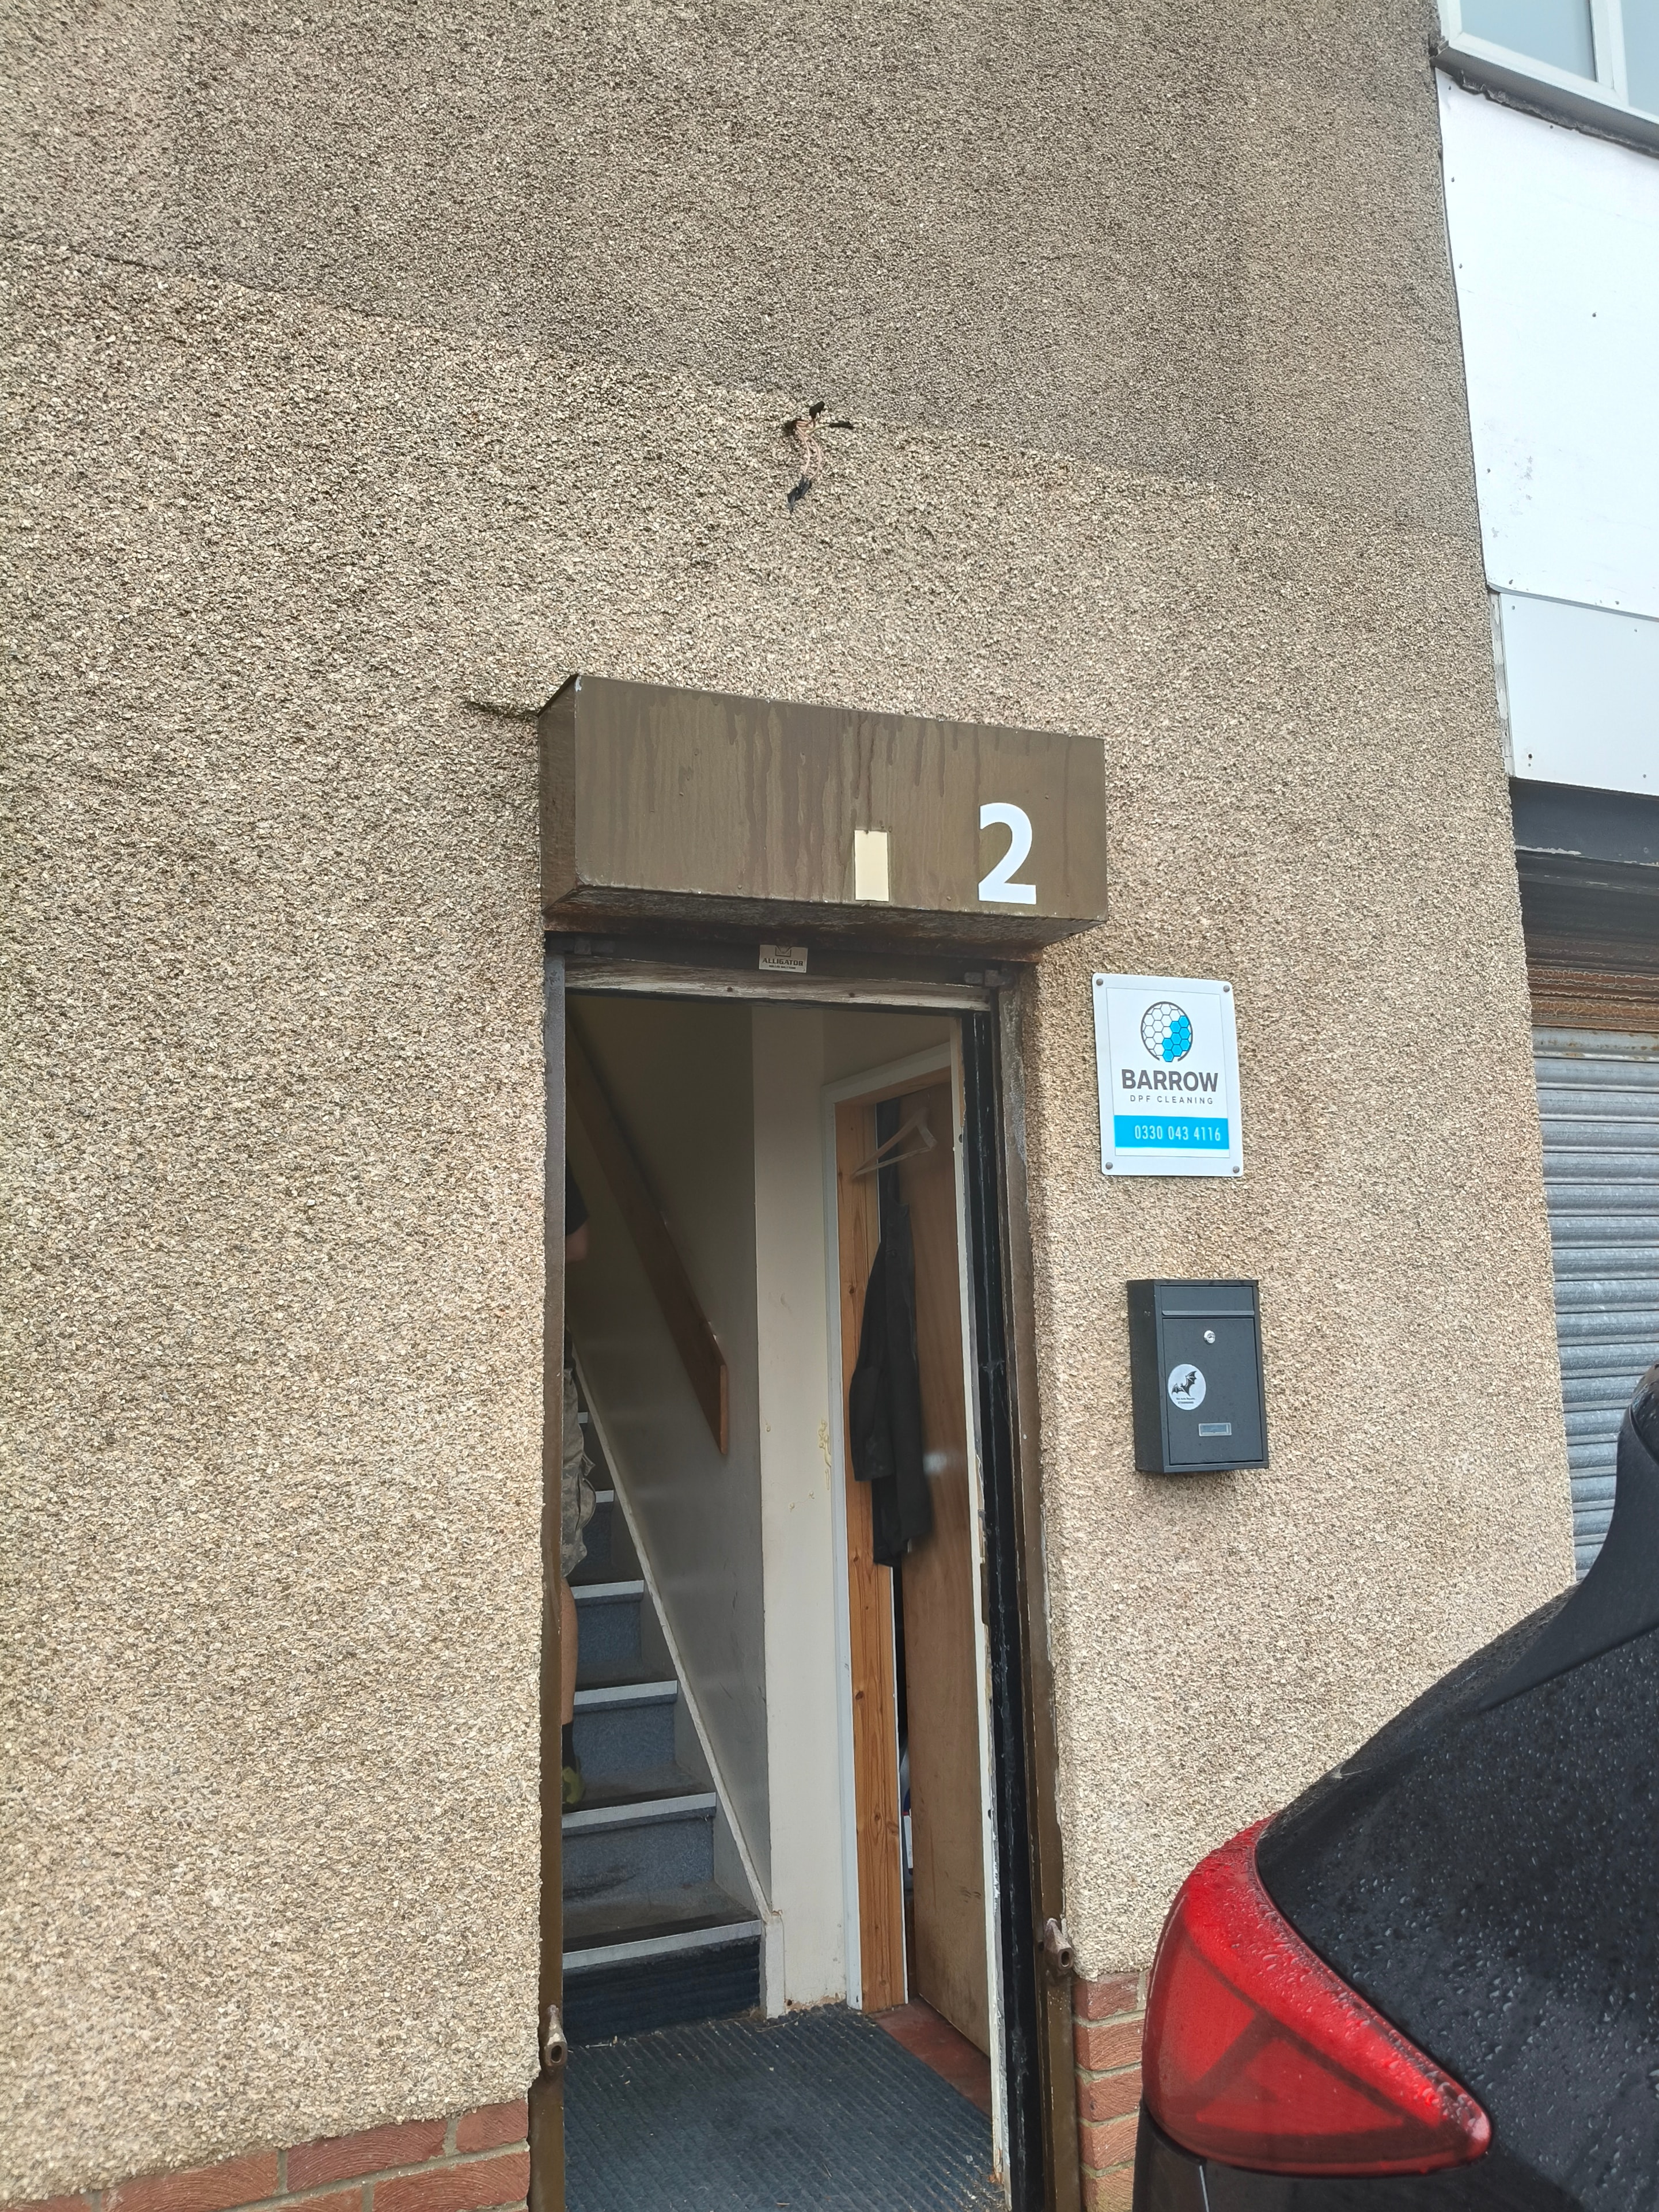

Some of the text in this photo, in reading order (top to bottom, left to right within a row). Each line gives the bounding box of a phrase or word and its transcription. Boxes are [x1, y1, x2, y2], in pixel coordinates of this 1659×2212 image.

[978, 802, 1037, 905] 2
[762, 958, 803, 966] ALLIGATOR
[1122, 1069, 1218, 1092] BARROW
[1157, 1096, 1213, 1104] CLEANING
[1135, 1125, 1221, 1141] 0330 043 4116
